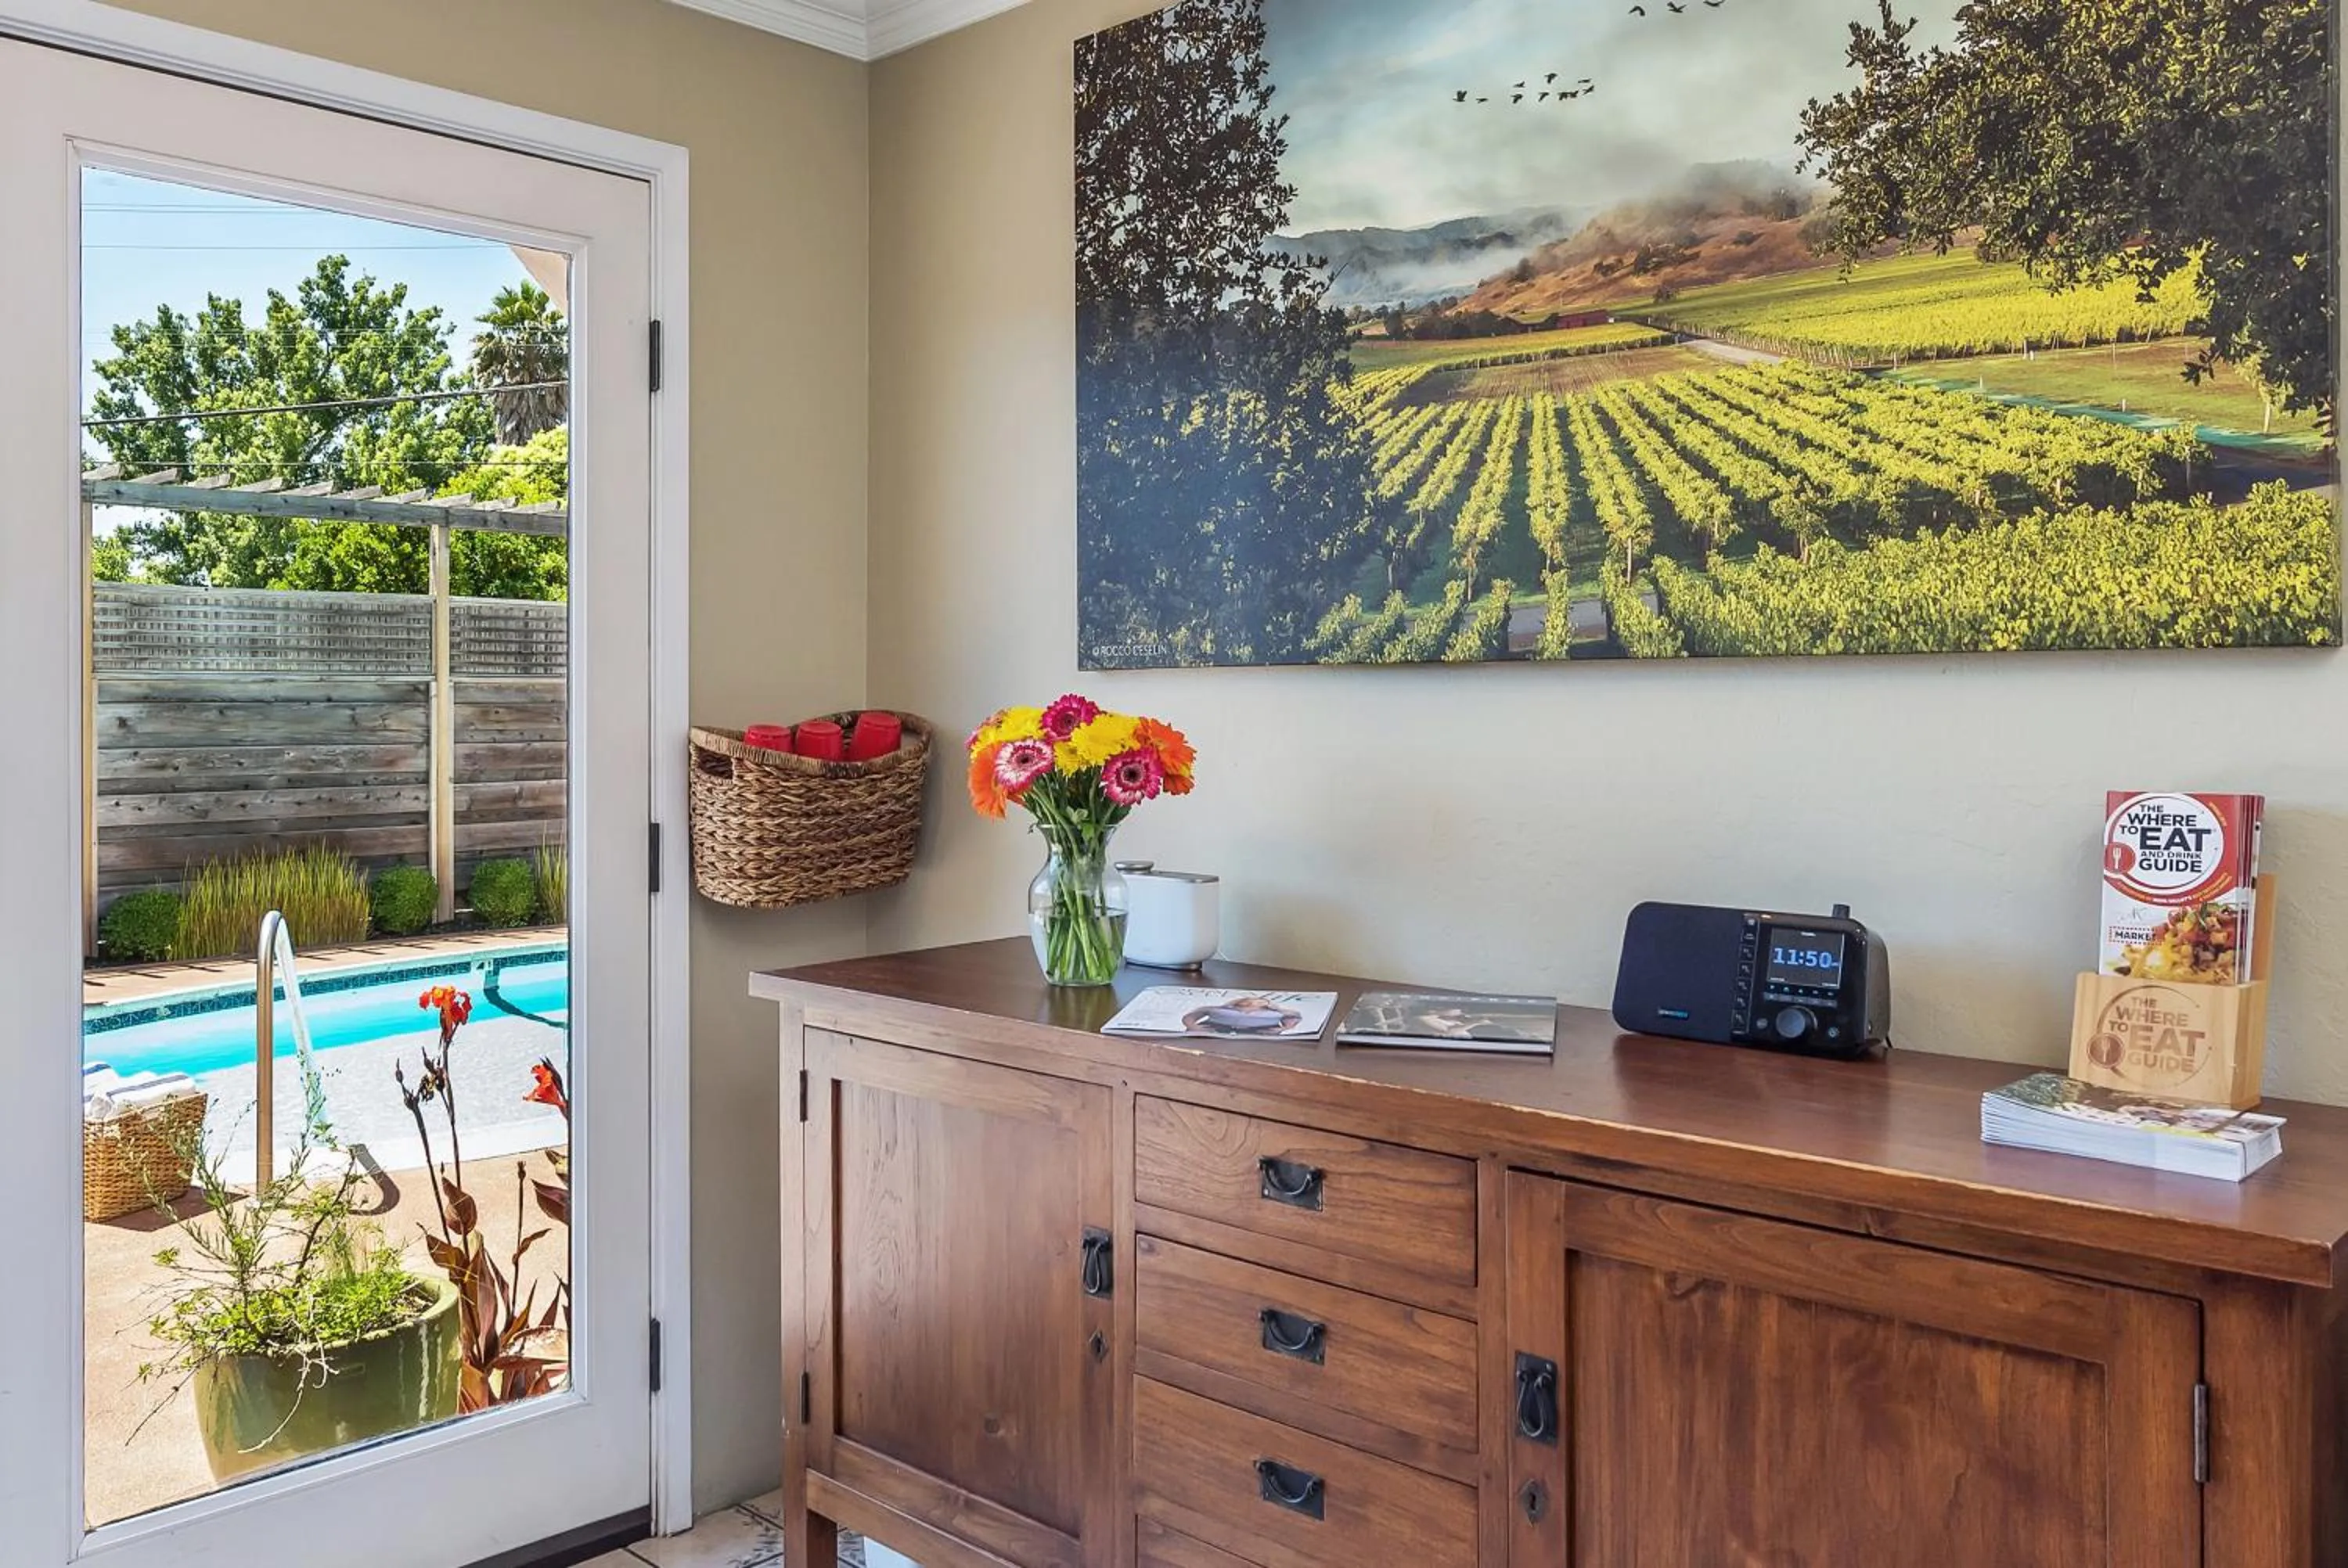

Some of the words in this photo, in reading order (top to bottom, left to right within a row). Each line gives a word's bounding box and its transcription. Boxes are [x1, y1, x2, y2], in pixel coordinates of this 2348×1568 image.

[2139, 804, 2164, 814] THE
[2127, 813, 2197, 827] WHERE
[2119, 824, 2138, 835] TO
[2139, 826, 2212, 852] EAT
[2141, 850, 2164, 858] AND
[2167, 851, 2202, 860] DRINK
[2139, 858, 2202, 873] GUIDE
[1773, 948, 1832, 968] 11:50
[2132, 997, 2157, 1008] THE
[2116, 1005, 2188, 1027] WHERE
[2108, 1020, 2129, 1033] TO
[2129, 1025, 2206, 1056] EAT
[2127, 1052, 2195, 1073] GUIDE
